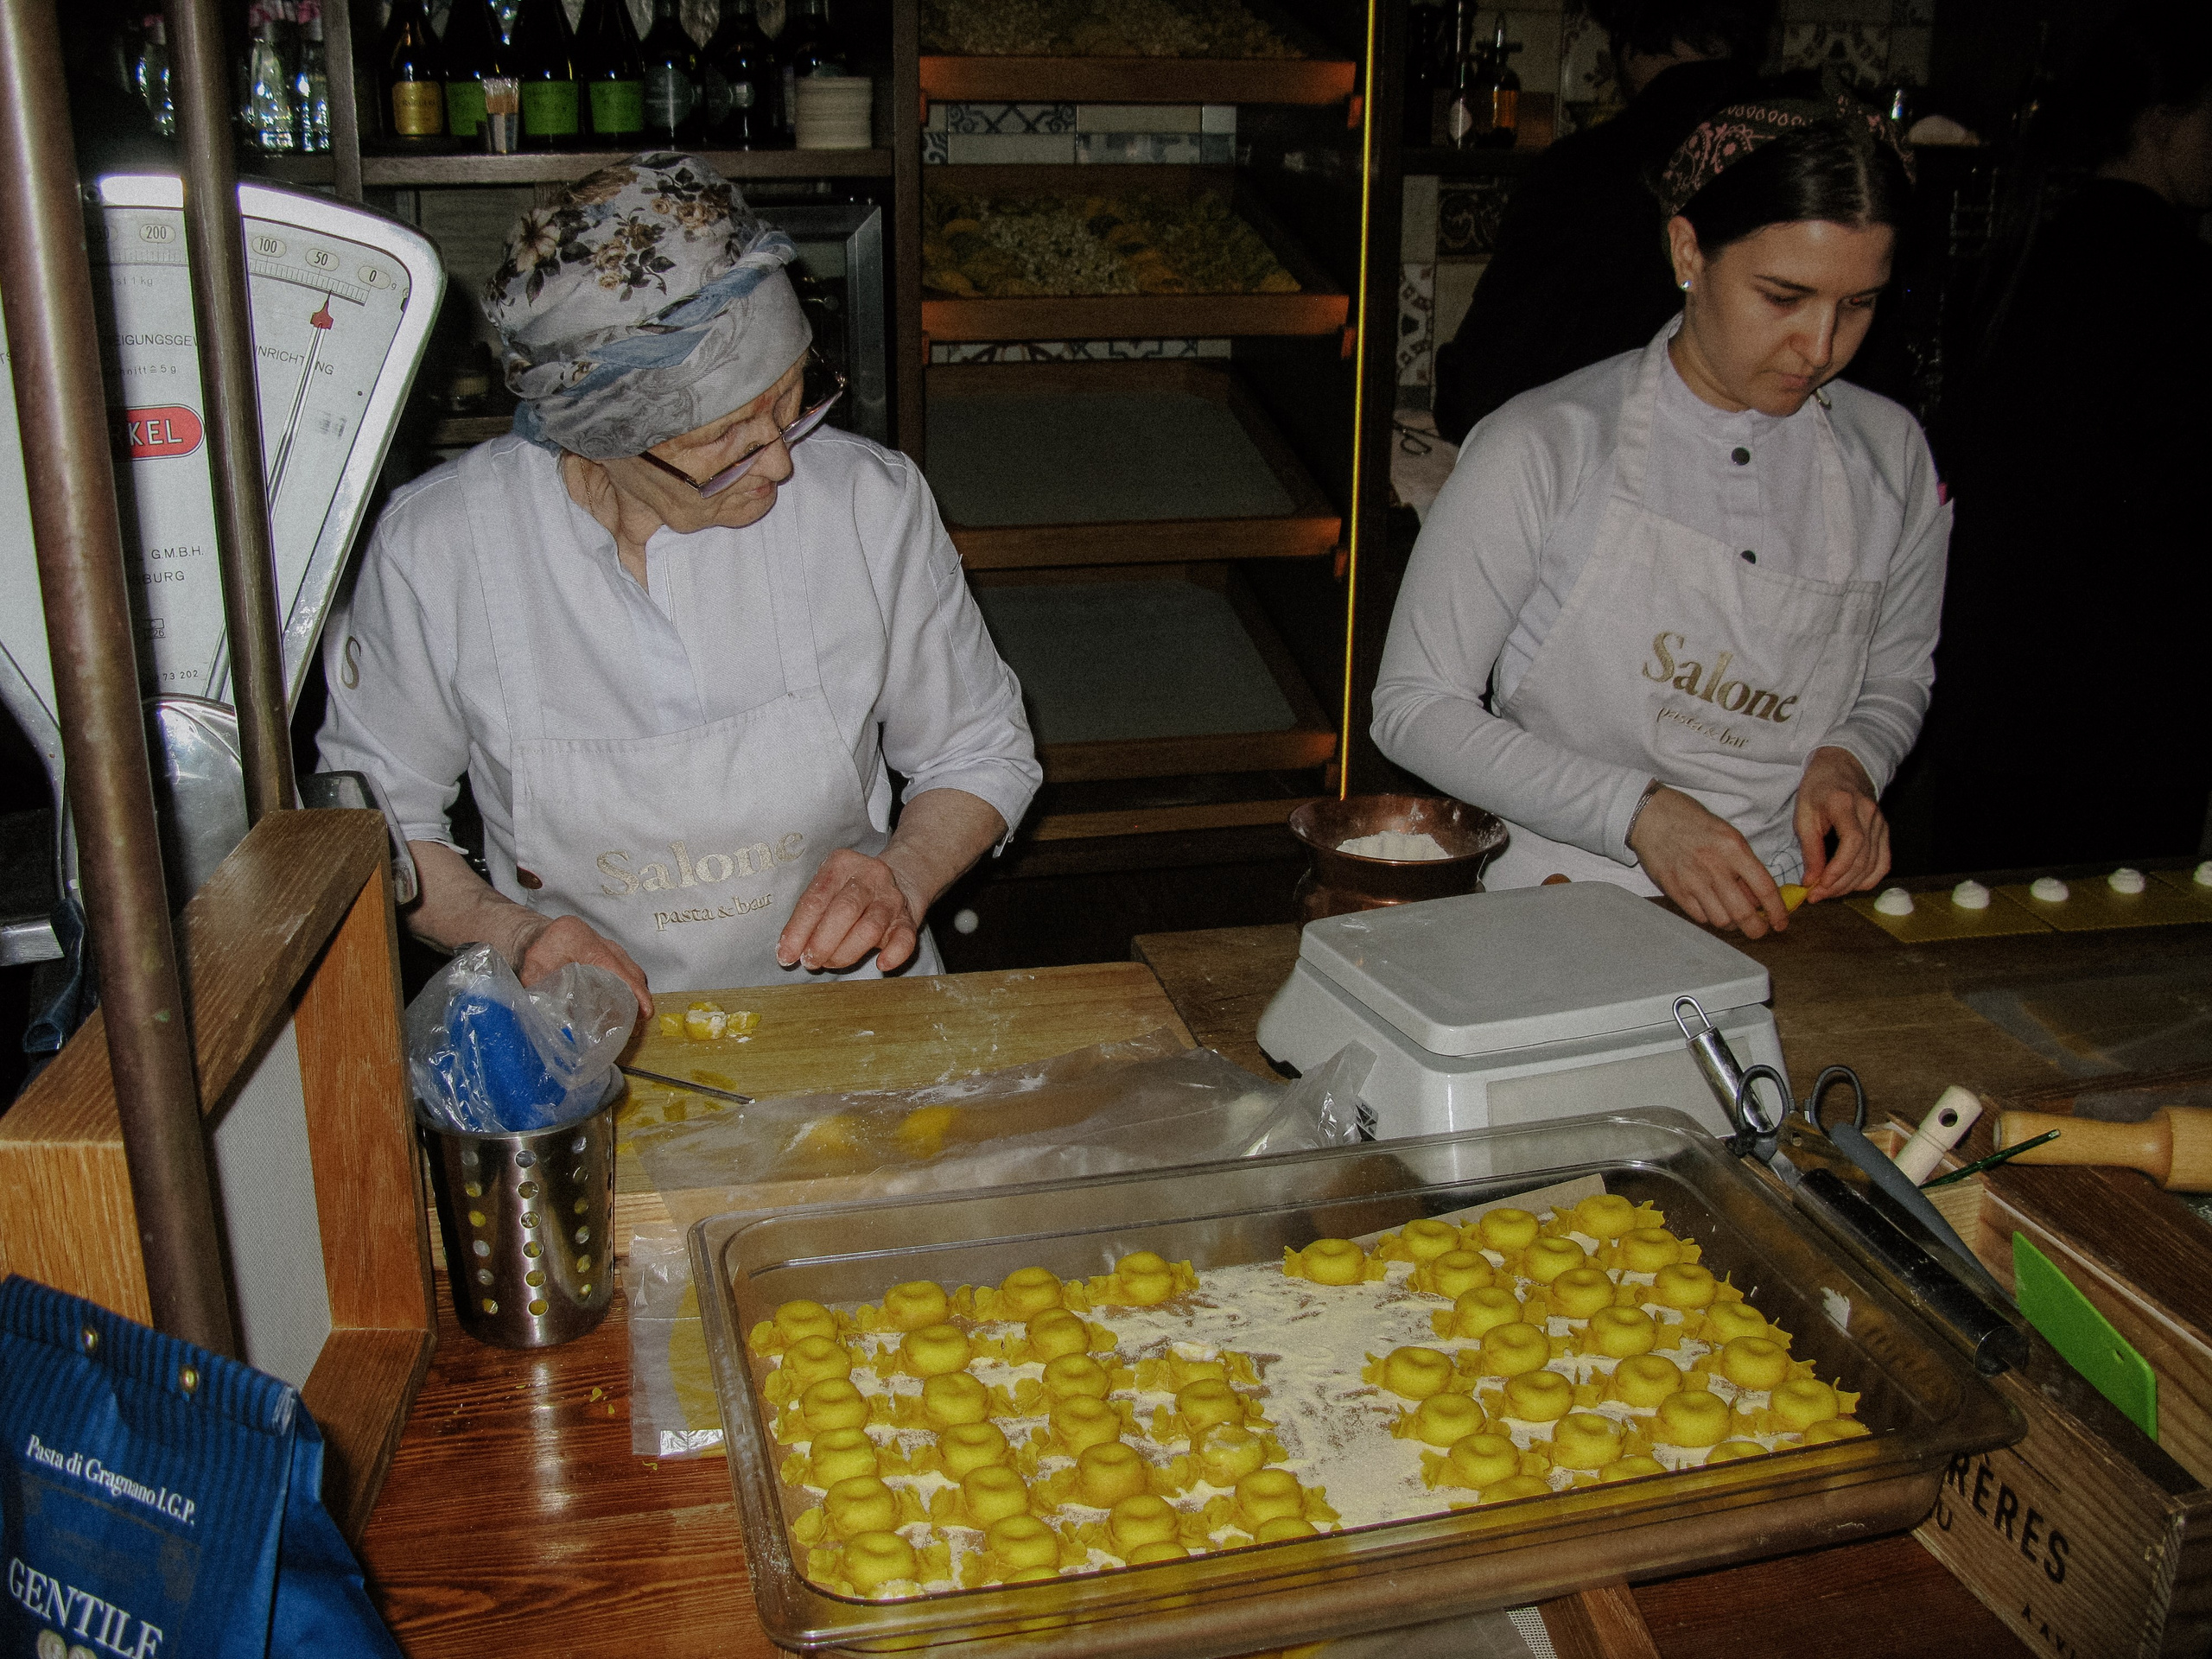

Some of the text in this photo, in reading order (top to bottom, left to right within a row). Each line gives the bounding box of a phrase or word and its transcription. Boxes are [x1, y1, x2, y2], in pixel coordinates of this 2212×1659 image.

[145, 226, 167, 239] 200
[259, 238, 277, 253] 100
[314, 251, 328, 266] 50
[369, 270, 377, 282] 0
[141, 276, 153, 288] kg
[120, 334, 198, 346] IGUNGSGE
[127, 419, 183, 447] KEL
[151, 545, 204, 560] G.M.B.H.
[143, 570, 185, 584] BURG
[180, 670, 199, 680] 202
[340, 634, 362, 691] S
[1643, 631, 1798, 723] Salone
[1656, 707, 1702, 732] pasta
[1719, 728, 1750, 748] bar
[596, 831, 807, 897] Salone
[653, 905, 715, 932] pasta
[733, 893, 774, 916] bar
[26, 1433, 195, 1527] Pasta di Gragnano I.G.P.
[1947, 1451, 2069, 1585] RÈRES
[8, 1556, 163, 1659] GENTILE
